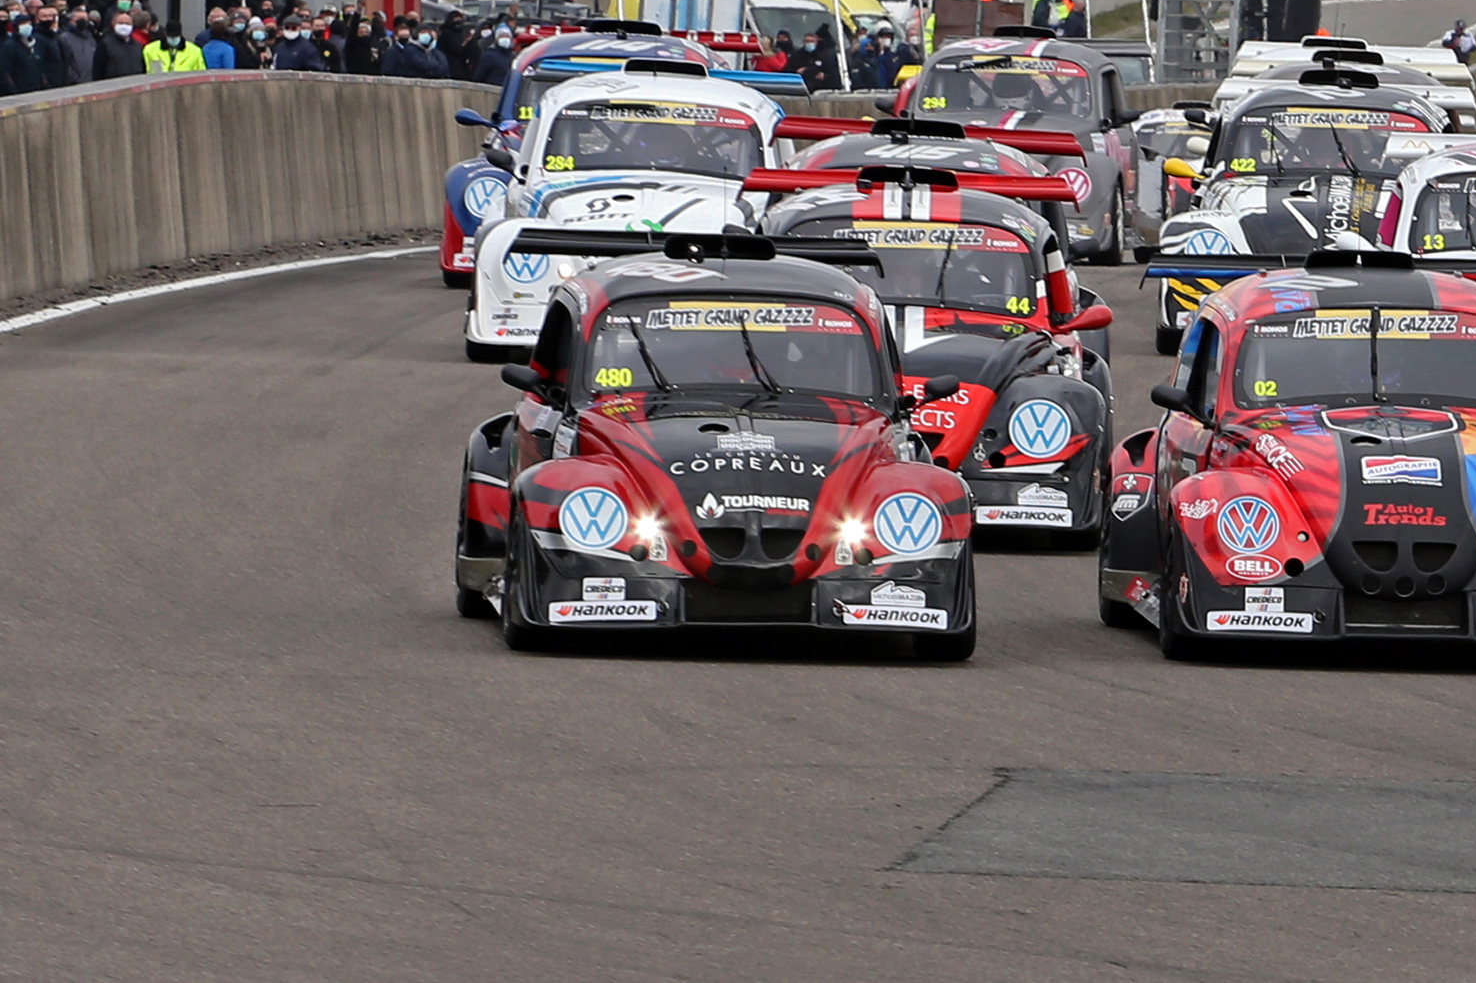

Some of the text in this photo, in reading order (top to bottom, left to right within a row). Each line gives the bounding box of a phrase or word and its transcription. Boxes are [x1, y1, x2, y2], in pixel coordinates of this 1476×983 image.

[1230, 158, 1257, 172] 422
[884, 228, 926, 245] GRAND
[928, 228, 985, 246] GAZZZZ
[1422, 234, 1446, 250] 13
[1005, 296, 1031, 315] 44
[646, 308, 701, 329] METTET
[703, 308, 751, 327] GRAND
[752, 306, 815, 326] GAZZZZ
[1293, 318, 1348, 338] METTET
[1349, 316, 1395, 335] GRND
[1397, 315, 1458, 334] GAZZZZ
[594, 367, 633, 387] 480
[1253, 380, 1278, 397] 02
[669, 456, 828, 478] COPREAUX
[1367, 461, 1438, 475] AUTOGRAPHE
[720, 494, 812, 511] TOURNEUR
[1383, 503, 1425, 515] Auto
[1363, 503, 1447, 526] Trends
[1233, 559, 1274, 573] BELL
